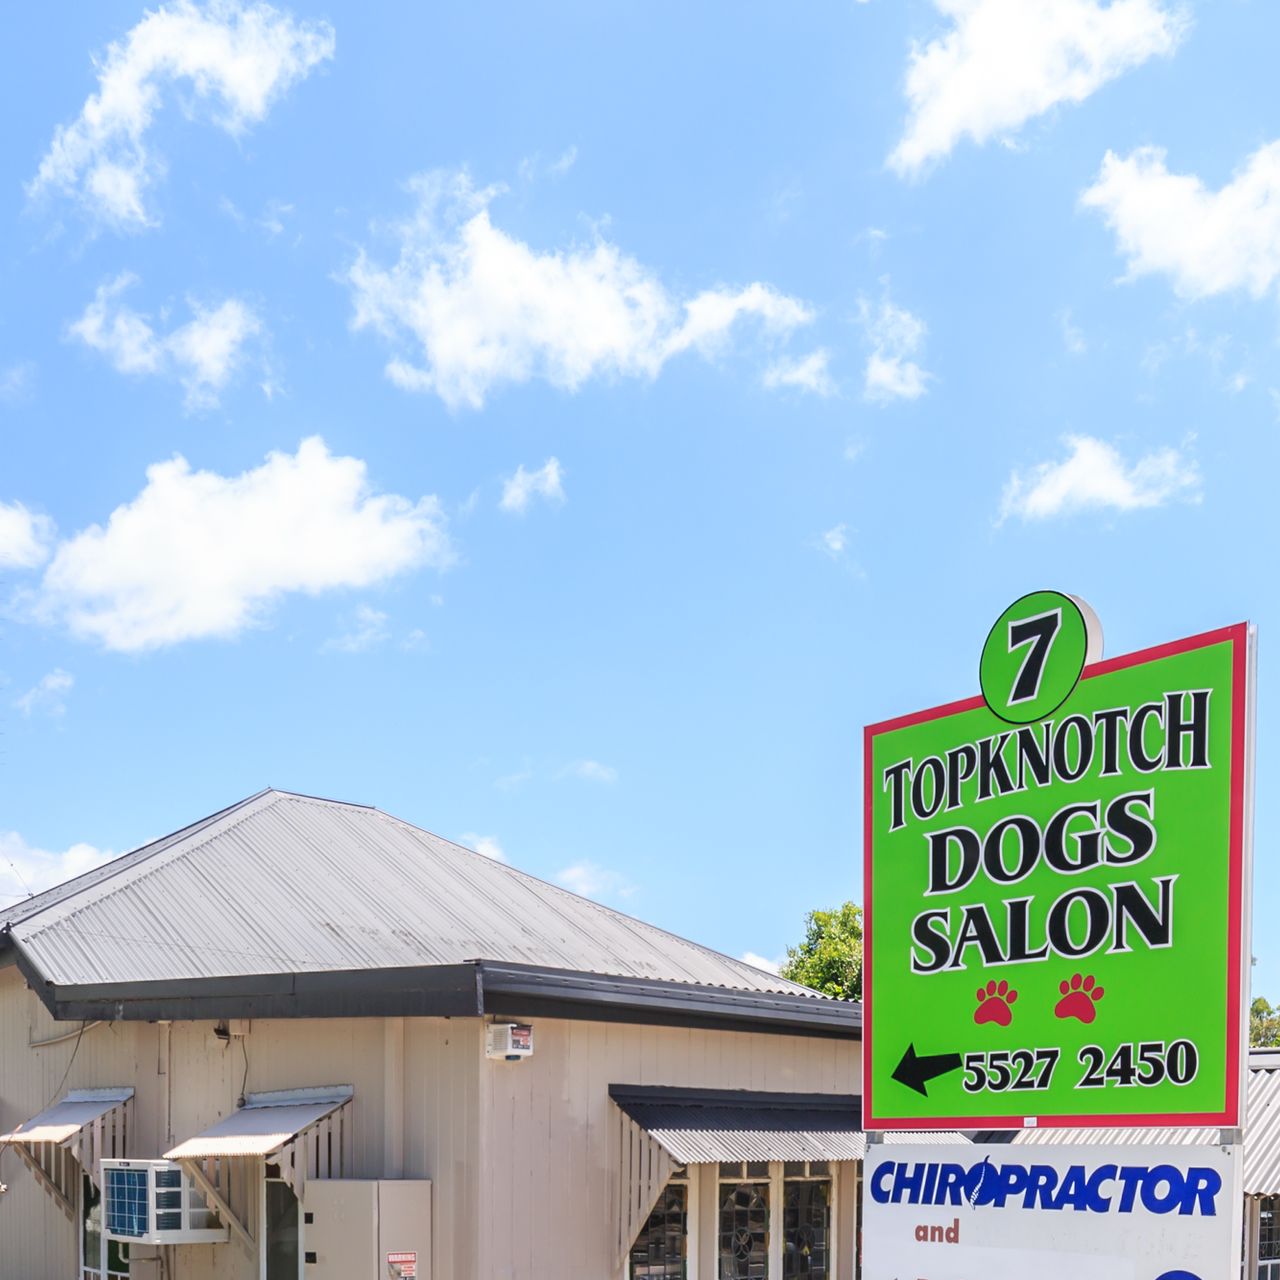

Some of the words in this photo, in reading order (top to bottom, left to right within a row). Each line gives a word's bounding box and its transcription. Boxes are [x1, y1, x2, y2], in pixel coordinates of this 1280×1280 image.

[1007, 608, 1062, 706] 7
[884, 689, 1213, 832] TOPKNOTCH
[924, 789, 1156, 897] DOGS
[910, 874, 1179, 976] SALON
[962, 1047, 1060, 1093] 5527
[1074, 1039, 1198, 1090] 2450
[870, 1155, 1221, 1216] CHIROPRACTOR
[915, 1218, 960, 1244] and
